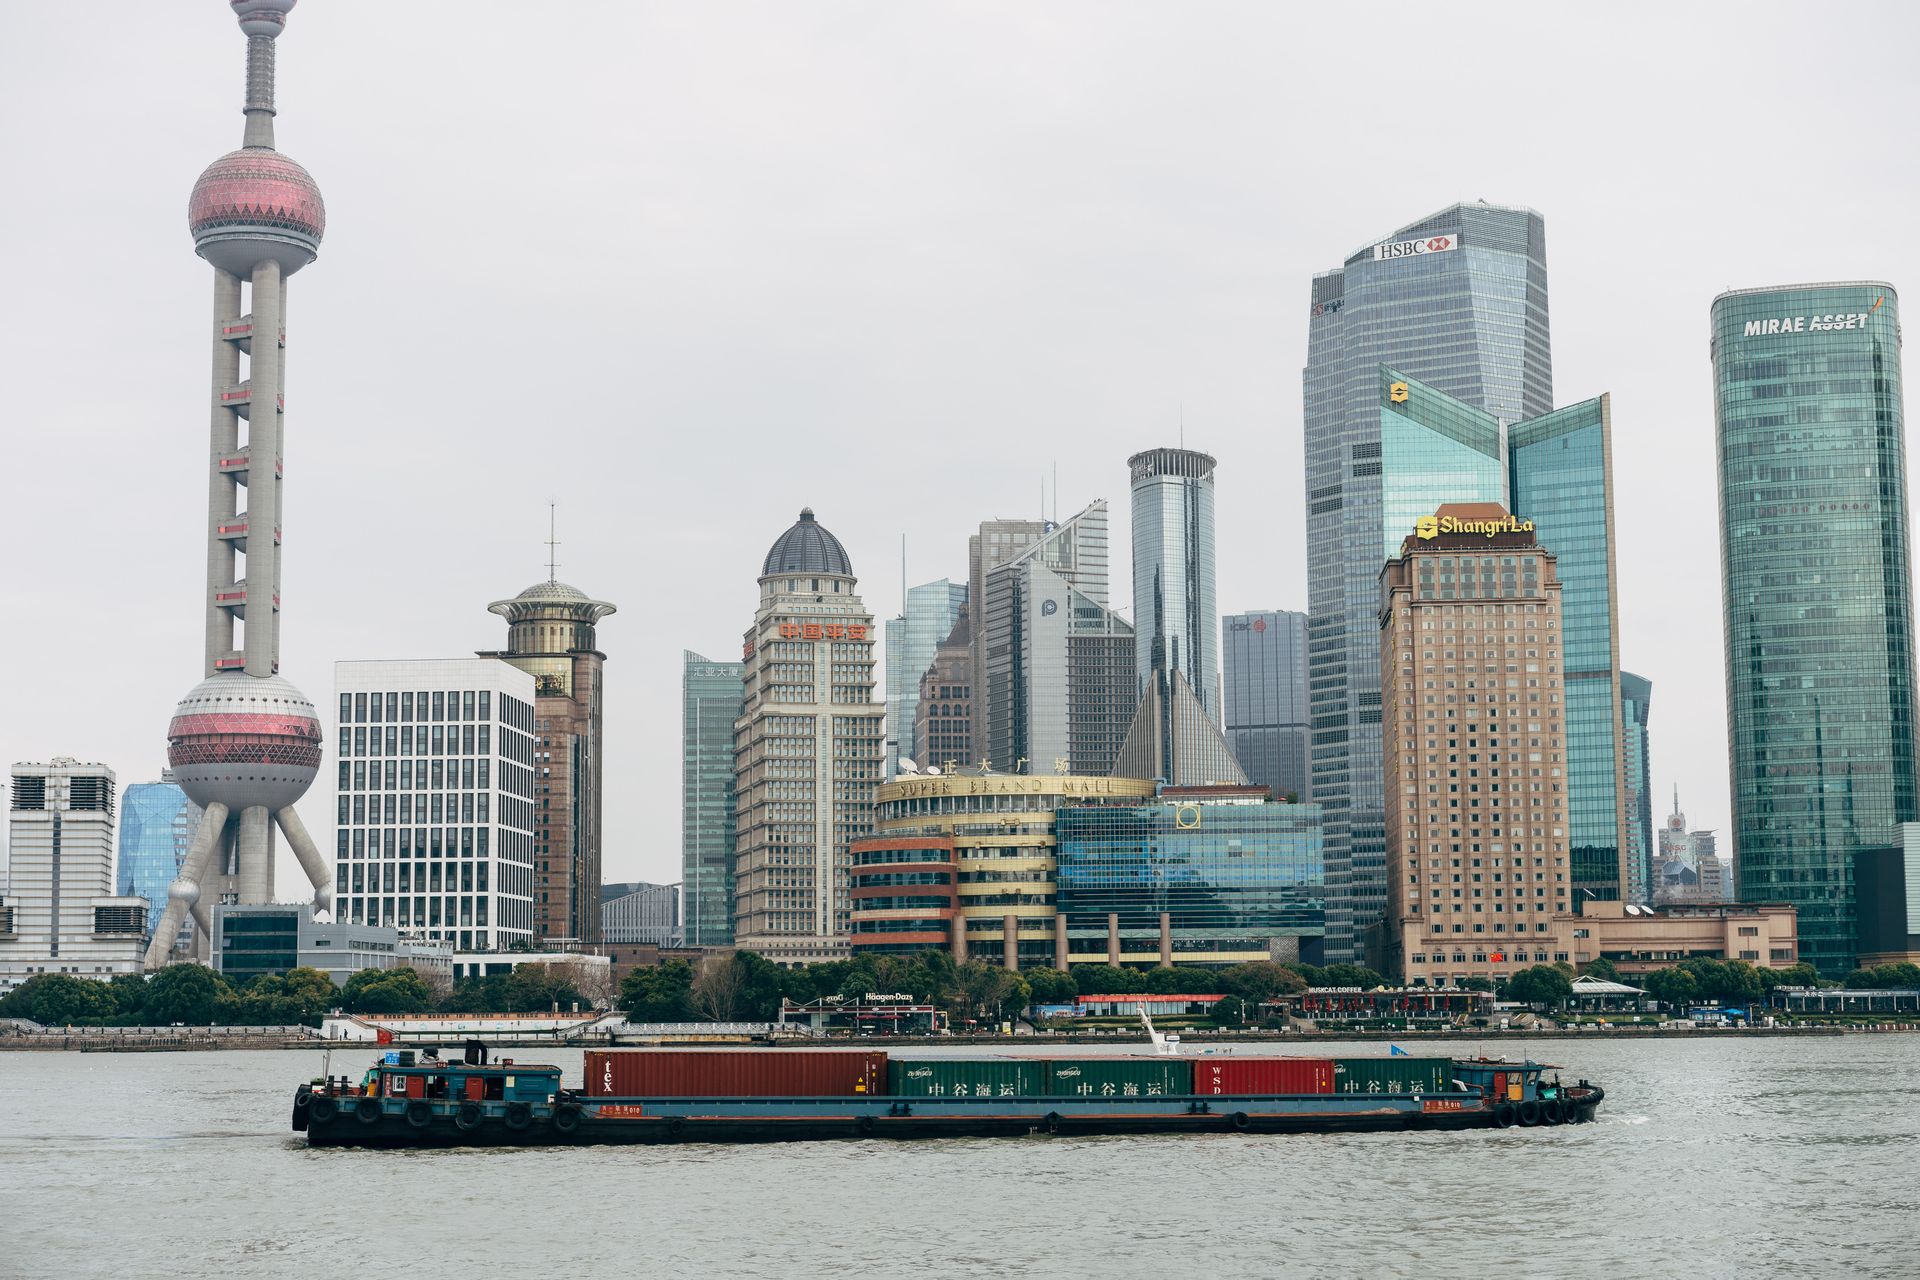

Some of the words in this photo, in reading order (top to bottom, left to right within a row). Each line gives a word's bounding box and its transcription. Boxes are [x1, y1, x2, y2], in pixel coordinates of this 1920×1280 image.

[1381, 240, 1425, 259] HSBC
[1743, 317, 1805, 337] MIRAE
[1809, 313, 1868, 332] ASSET
[1440, 515, 1534, 538] Shangri-La
[779, 623, 867, 640] 中国平安
[693, 667, 739, 677] 汇亚大厦
[943, 757, 1070, 776] 正大广场
[899, 781, 951, 797] SUPER
[969, 779, 1042, 793] BRAND
[1062, 780, 1114, 793] MALL
[865, 992, 913, 1003] Häagen-Dazs
[603, 1060, 612, 1092] tex
[928, 1082, 1015, 1097] 中谷海运
[1077, 1082, 1162, 1096] 中谷海运
[1344, 1080, 1425, 1094] 中谷海运
